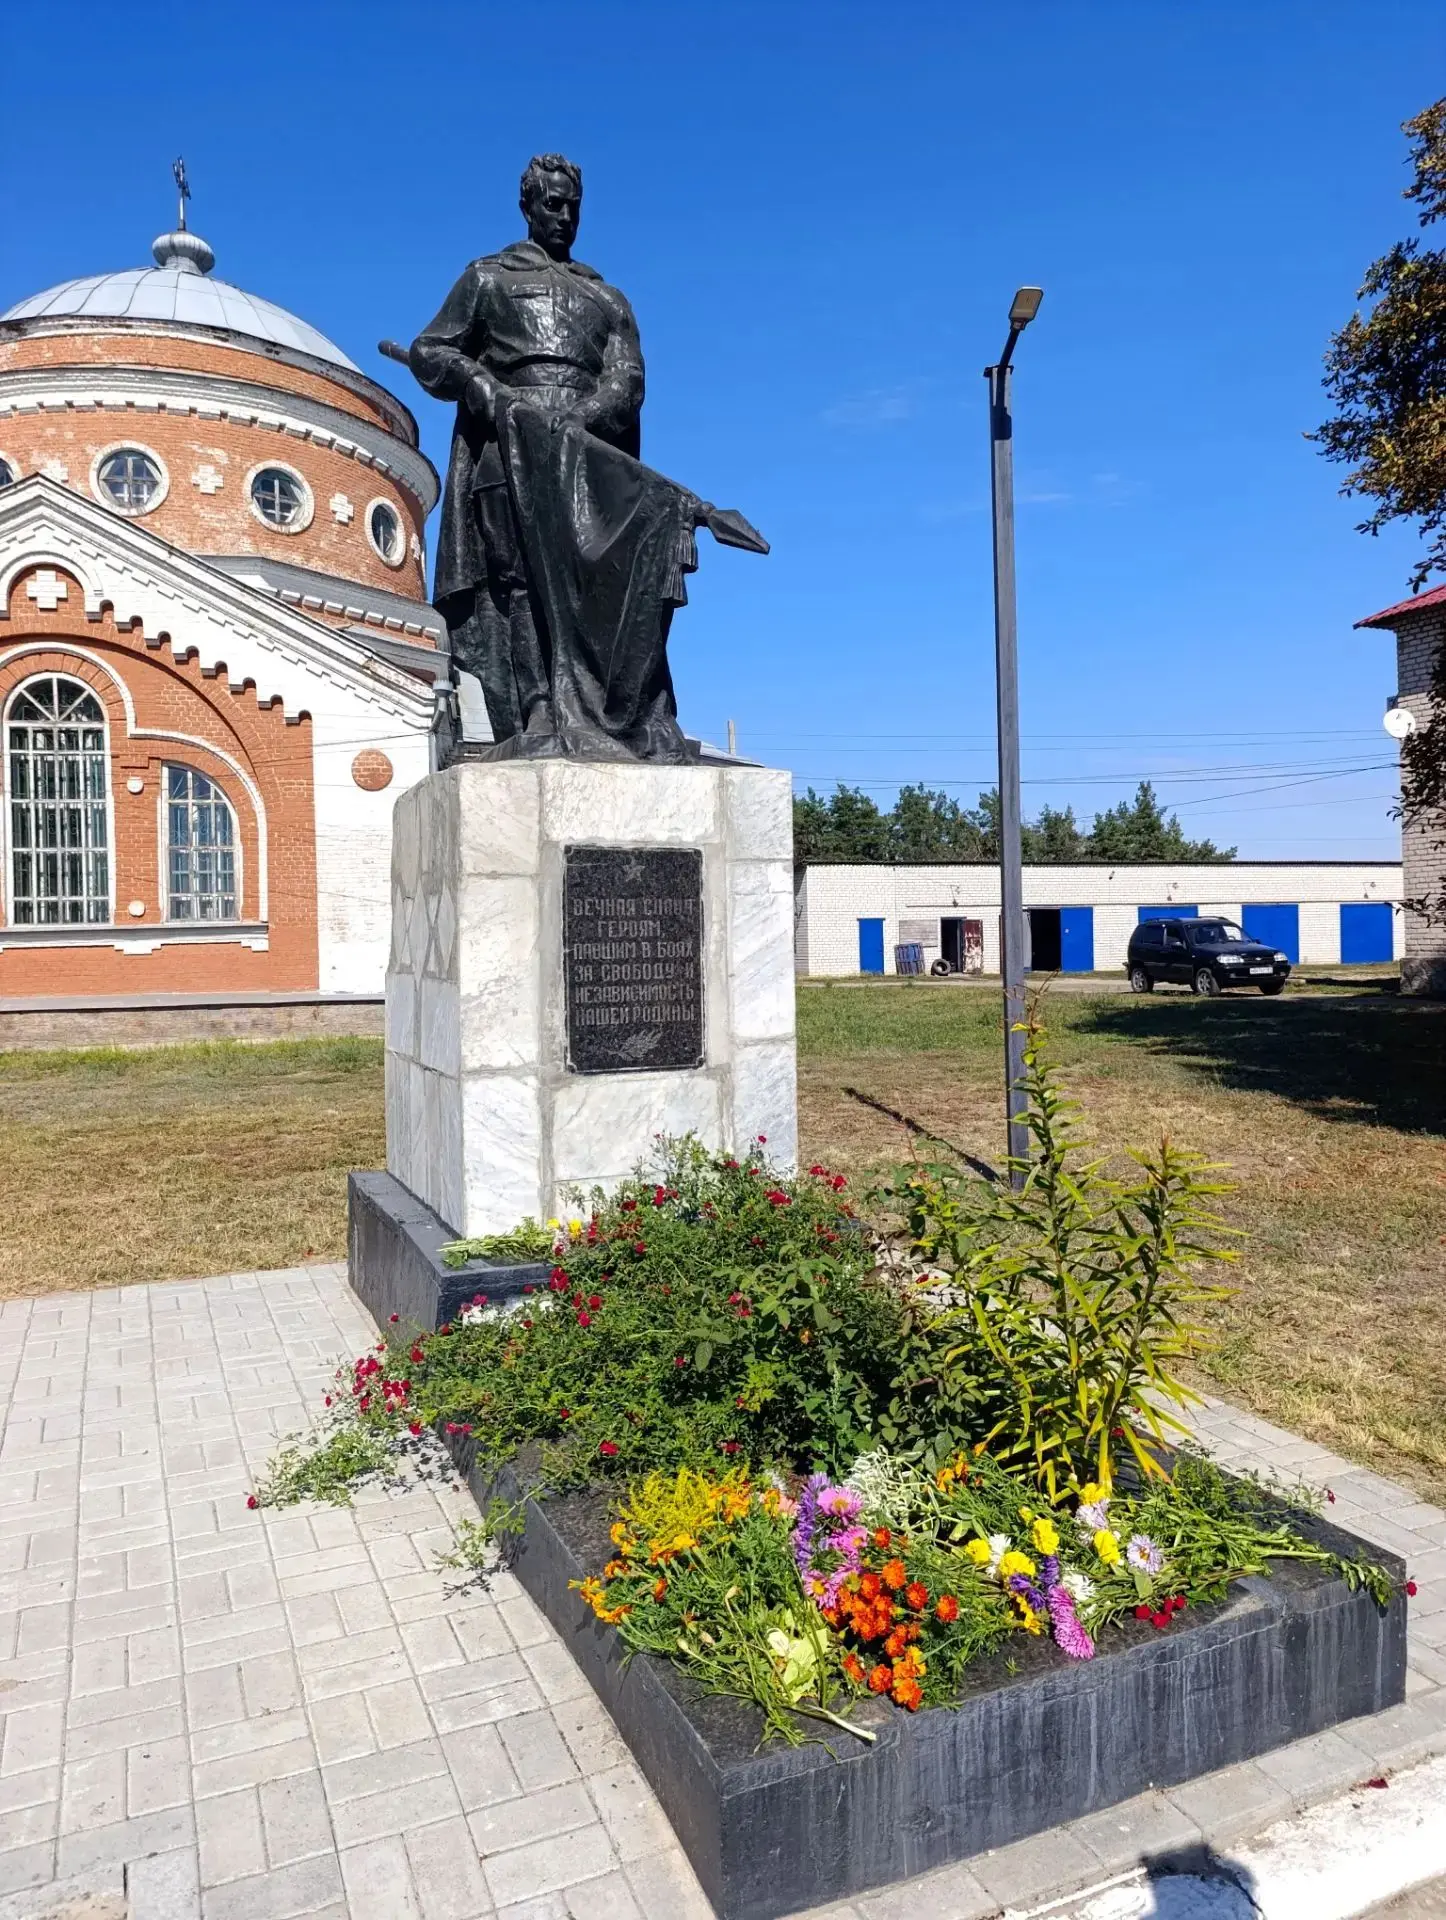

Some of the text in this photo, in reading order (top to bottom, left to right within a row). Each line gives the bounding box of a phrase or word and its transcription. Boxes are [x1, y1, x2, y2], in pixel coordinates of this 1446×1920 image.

[573, 898, 695, 916] ВЕЧНАЯ СЛАВА
[574, 941, 694, 960] ПАВШИМ В БОЯХ
[574, 961, 694, 982] ЗА СВОБОДУ И
[575, 983, 694, 1003] НЕЗАВИСИМОСТЬ
[575, 1003, 695, 1026] НАШЕЙ РОДИНЫ
